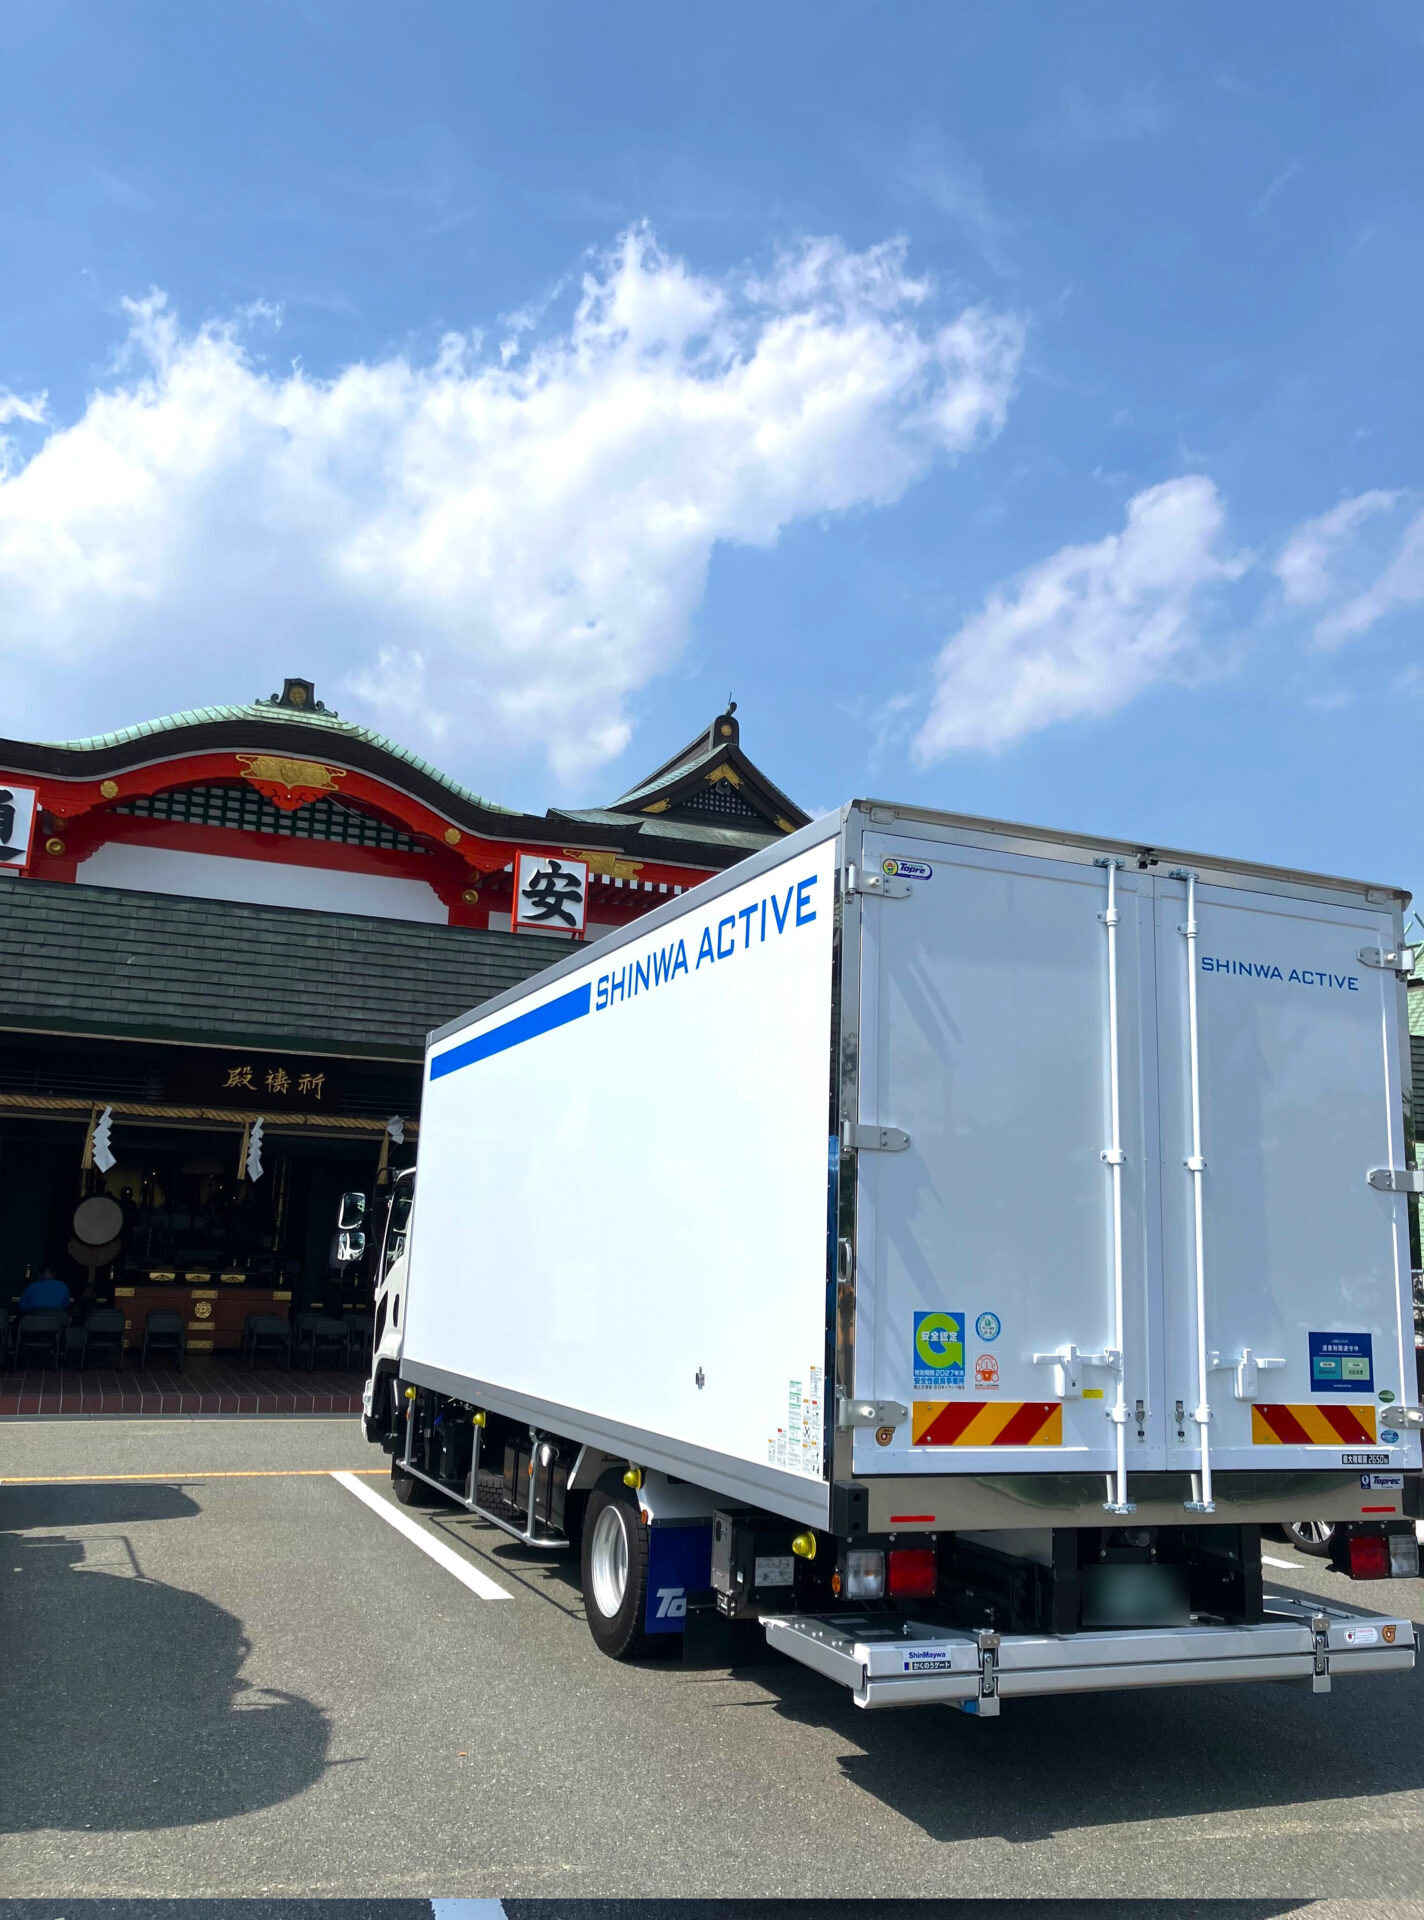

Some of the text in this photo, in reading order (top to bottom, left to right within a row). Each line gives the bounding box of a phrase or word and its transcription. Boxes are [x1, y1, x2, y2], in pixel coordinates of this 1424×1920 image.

[900, 863, 926, 874] Topre
[522, 860, 583, 927] 安
[596, 874, 818, 1011] SHINWA ACTIVE
[1201, 957, 1358, 991] SHINWA ACTIVE
[921, 1331, 958, 1342] 安全認定
[1373, 1476, 1400, 1486] Toprec
[914, 1661, 950, 1669] かくのうゲート
